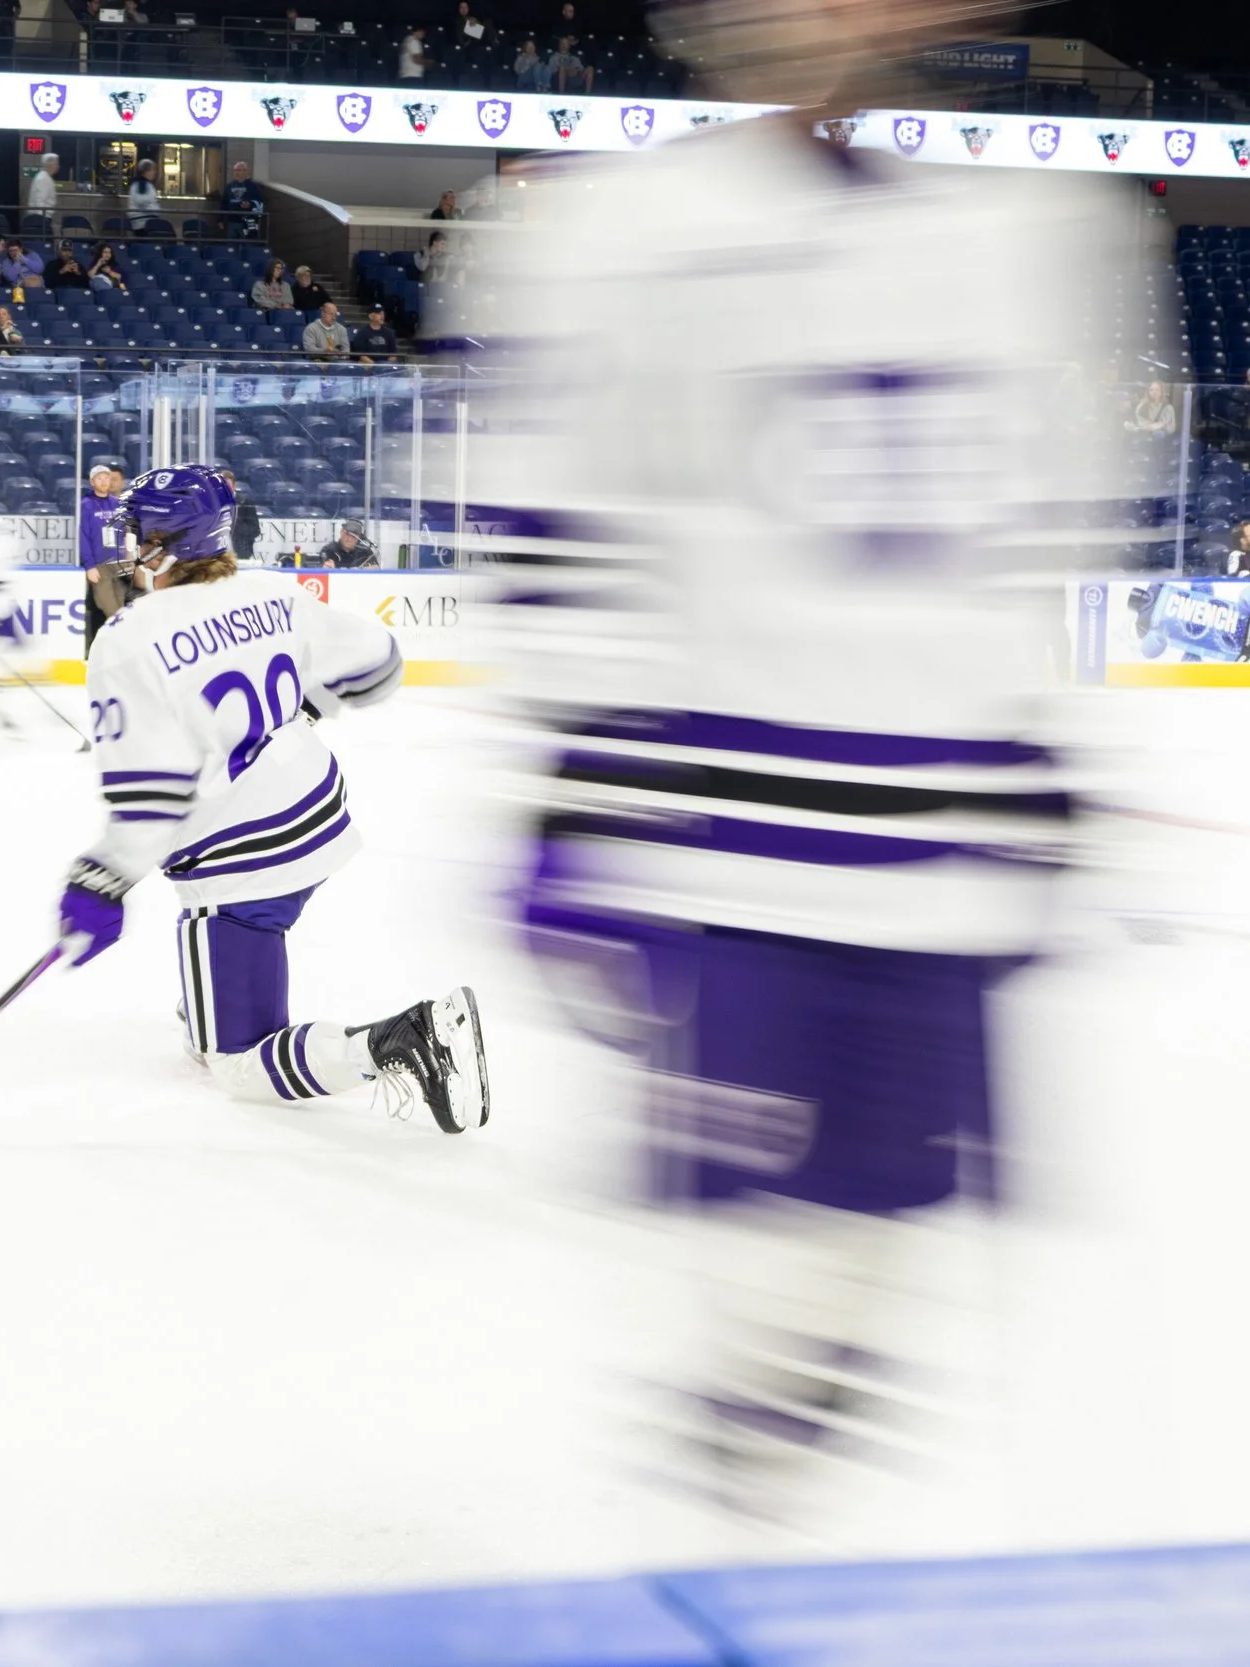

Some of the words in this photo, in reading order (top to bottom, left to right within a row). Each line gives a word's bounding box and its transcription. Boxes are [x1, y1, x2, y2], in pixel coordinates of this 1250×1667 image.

[963, 52, 1017, 70] LIGHT
[402, 596, 460, 627] MB
[1164, 593, 1239, 634] CWENCH
[154, 597, 295, 674] LOUNSBURY
[90, 697, 127, 743] 20
[199, 652, 302, 784] 20
